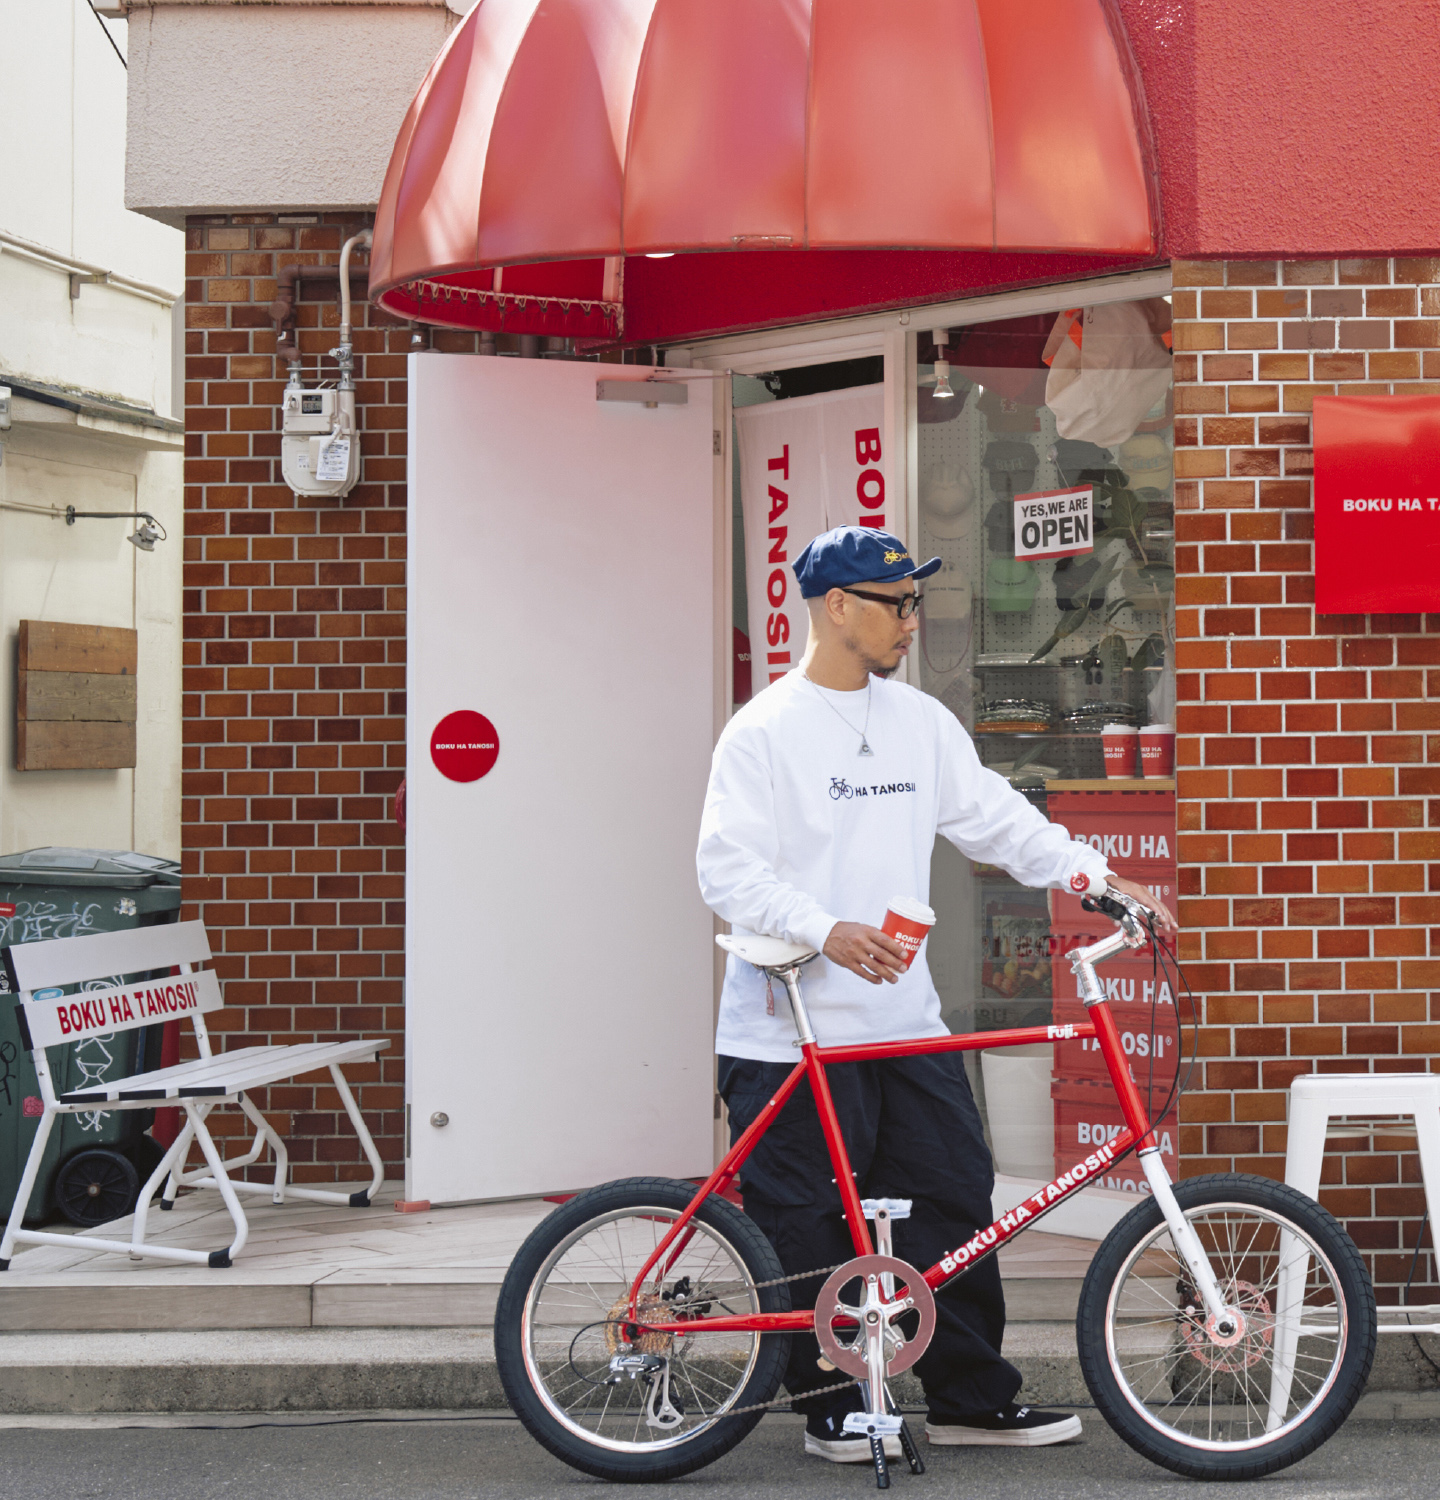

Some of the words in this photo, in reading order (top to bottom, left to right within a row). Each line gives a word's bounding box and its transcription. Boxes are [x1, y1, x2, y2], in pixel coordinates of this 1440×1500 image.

[1068, 497, 1088, 512] ARE
[1343, 498, 1393, 512] BOKU
[1398, 498, 1423, 511] HA
[1021, 513, 1090, 549] OPEN
[855, 786, 869, 797] HA
[870, 782, 916, 795] TANOSII
[1140, 835, 1171, 858] HA
[895, 931, 920, 944] BOKU
[1143, 980, 1173, 1005] HA
[56, 998, 106, 1035] BOKU
[108, 994, 135, 1024] HA
[939, 1226, 998, 1274] BOKU
[999, 1205, 1032, 1232] HA
